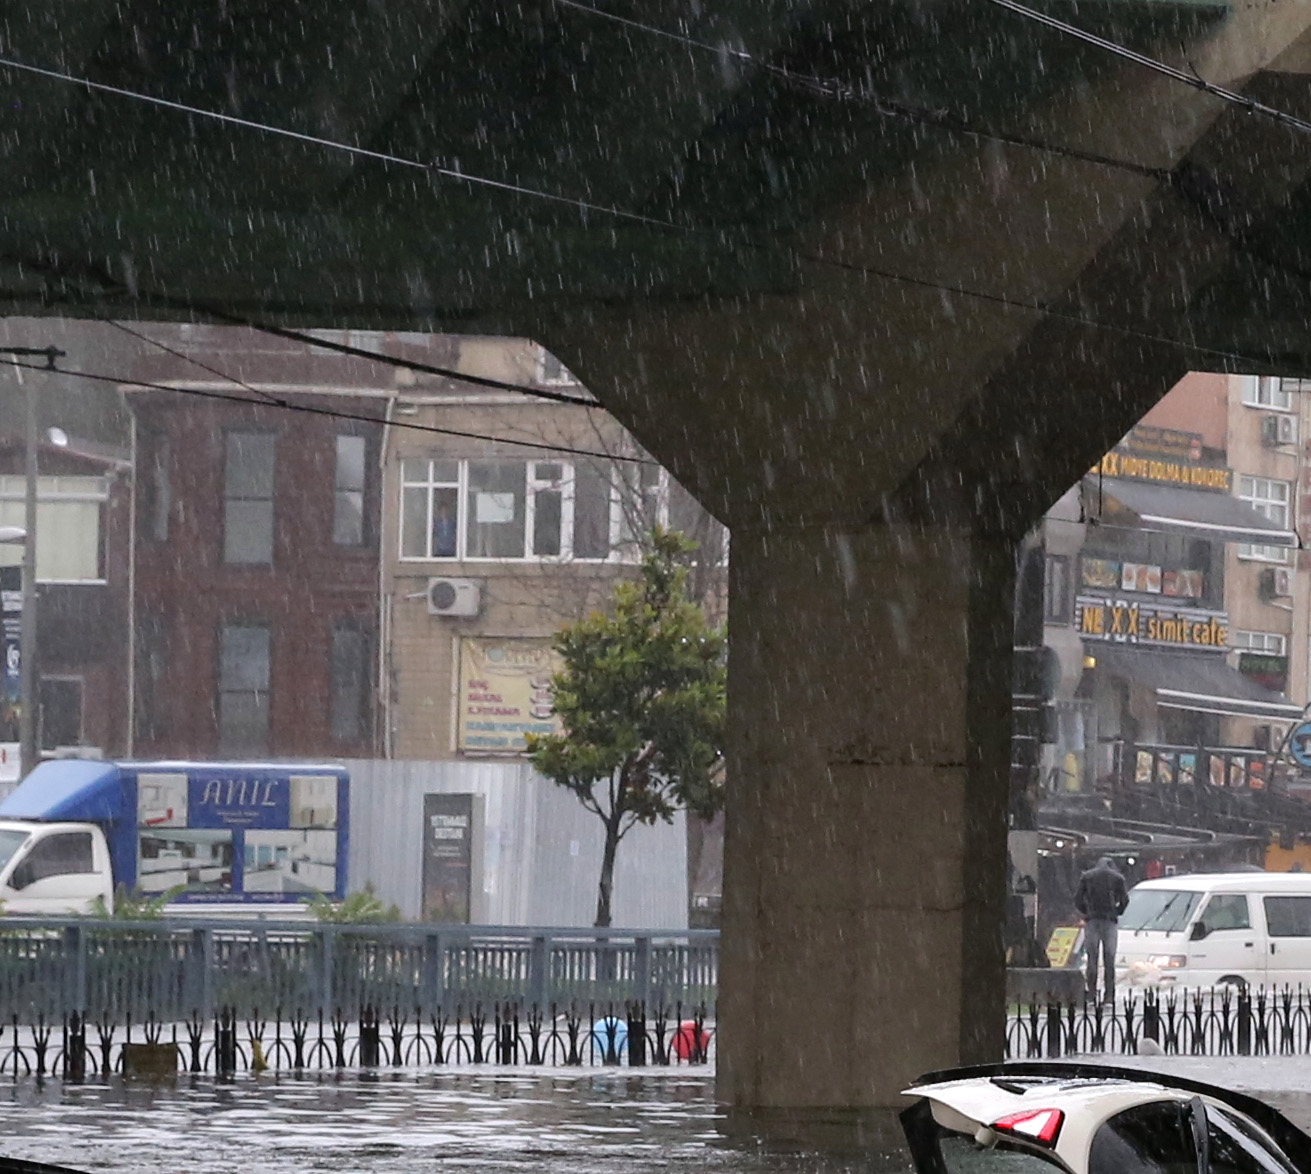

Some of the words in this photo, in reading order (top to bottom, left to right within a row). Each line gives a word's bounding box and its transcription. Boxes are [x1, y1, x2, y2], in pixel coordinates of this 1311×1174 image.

[1148, 610, 1188, 642] simit
[1192, 616, 1226, 646] cafe
[199, 779, 279, 806] ANIL
